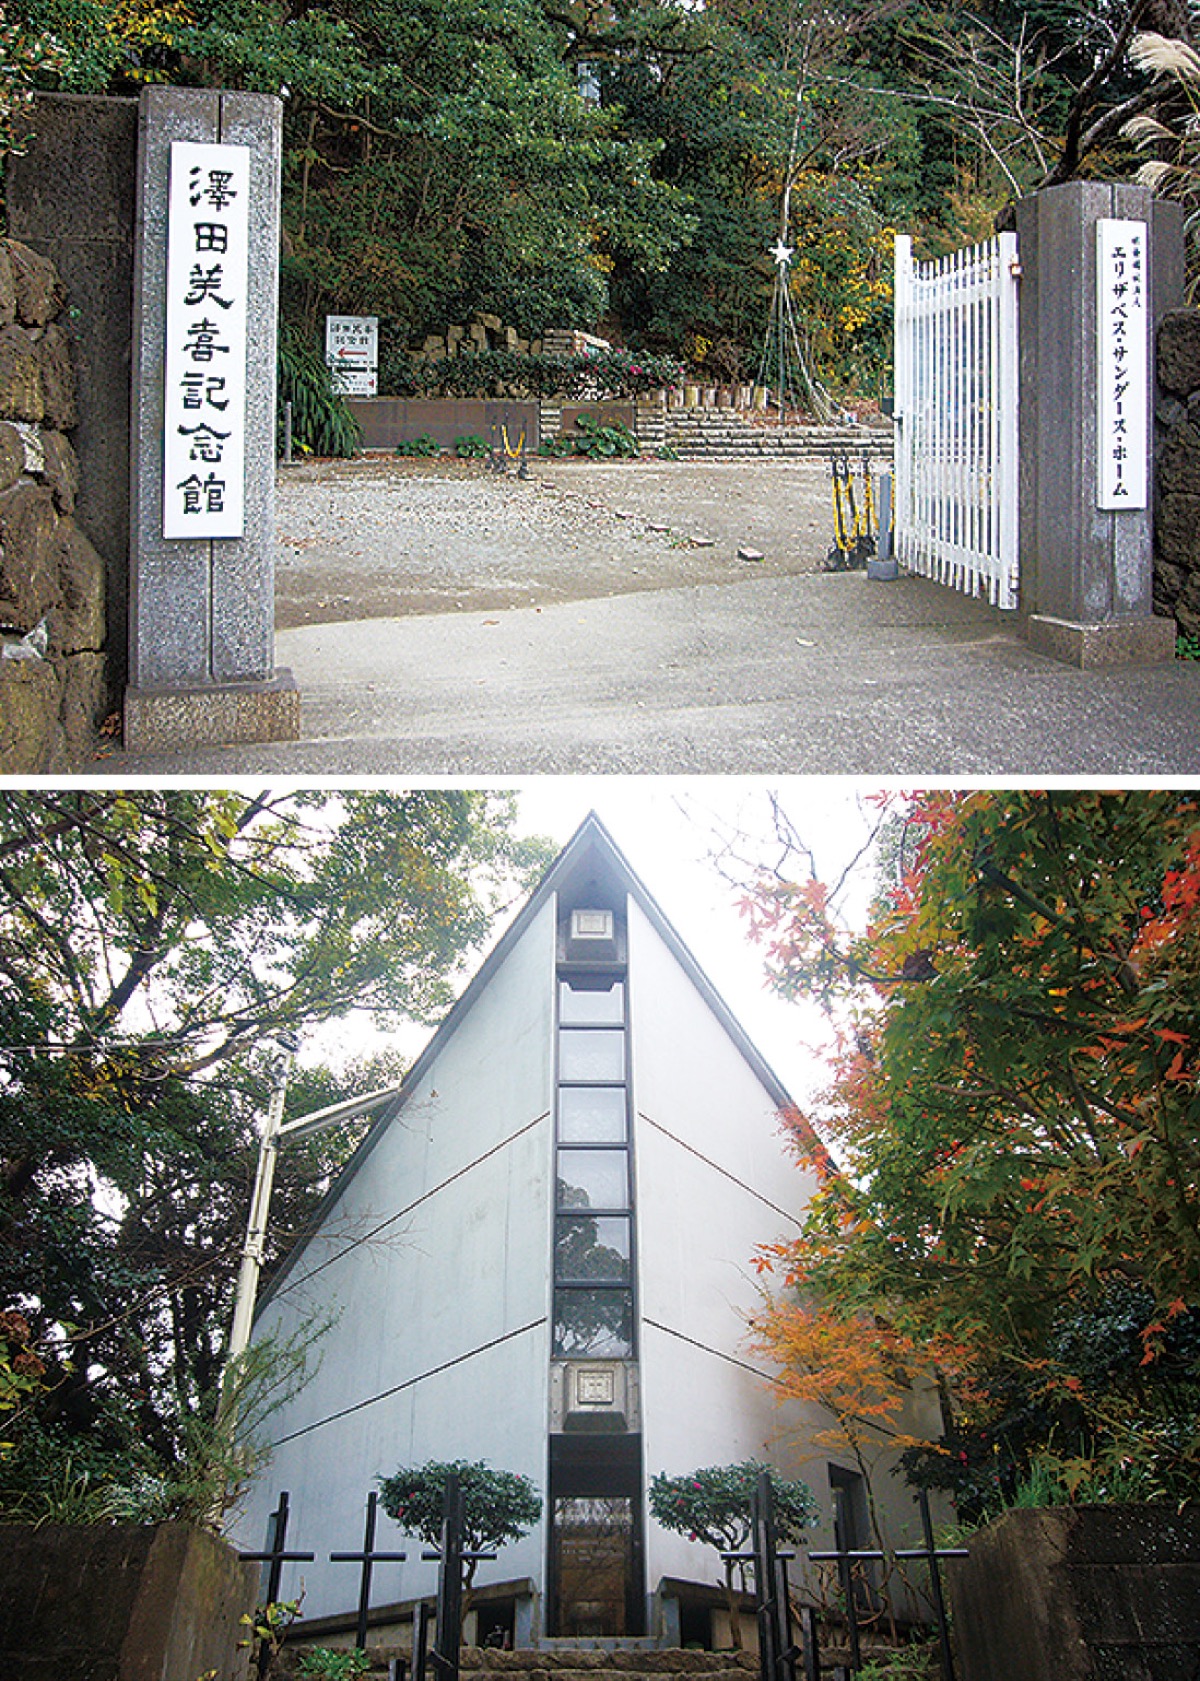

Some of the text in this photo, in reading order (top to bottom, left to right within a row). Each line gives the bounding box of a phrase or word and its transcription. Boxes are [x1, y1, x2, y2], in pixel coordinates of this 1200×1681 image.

[176, 166, 238, 515] 澤田美喜記念館
